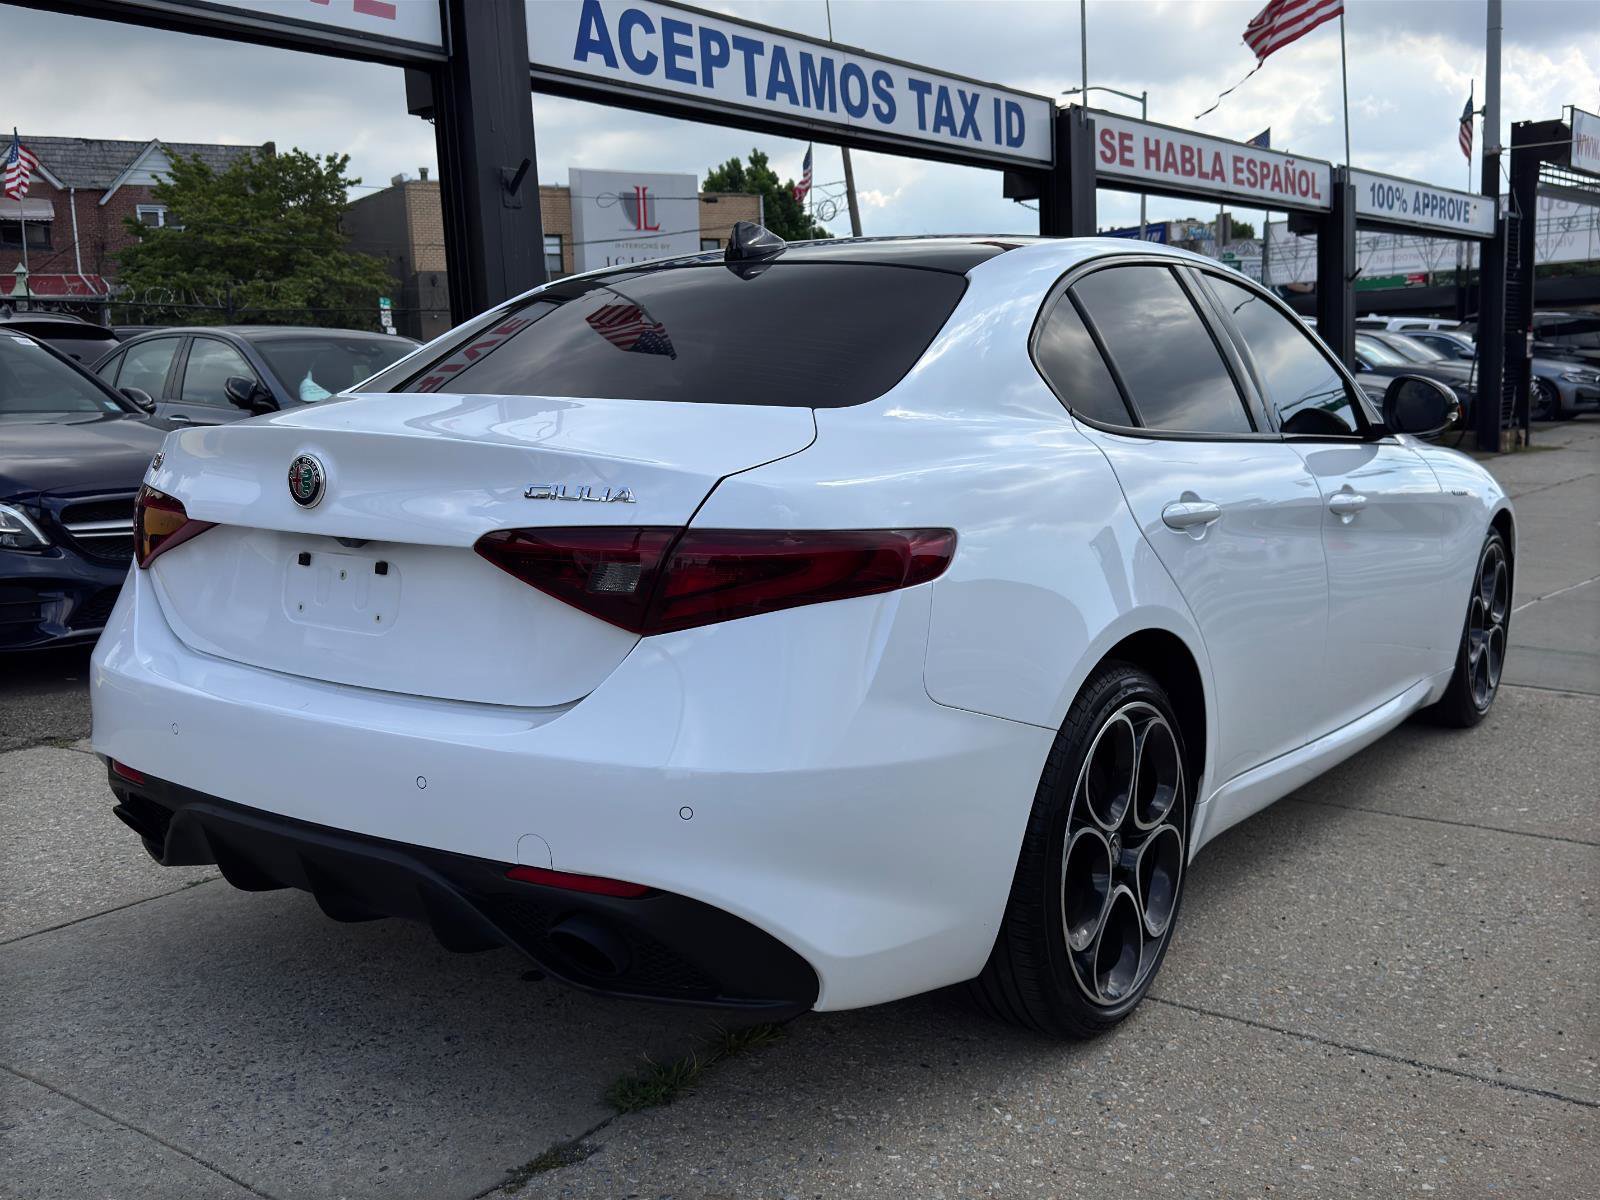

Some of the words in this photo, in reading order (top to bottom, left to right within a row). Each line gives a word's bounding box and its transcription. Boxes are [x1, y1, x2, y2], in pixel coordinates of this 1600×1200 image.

[574, 0, 897, 124] ACEPTAMOS
[908, 77, 982, 142] TAX
[993, 97, 1026, 149] ID
[1100, 128, 1134, 167] SE
[1143, 137, 1226, 183] HABLA
[1232, 155, 1321, 200] ESPAÑOL
[1370, 182, 1408, 213] 100%
[1412, 190, 1470, 224] APPROVE
[524, 483, 637, 503] GIULIA
